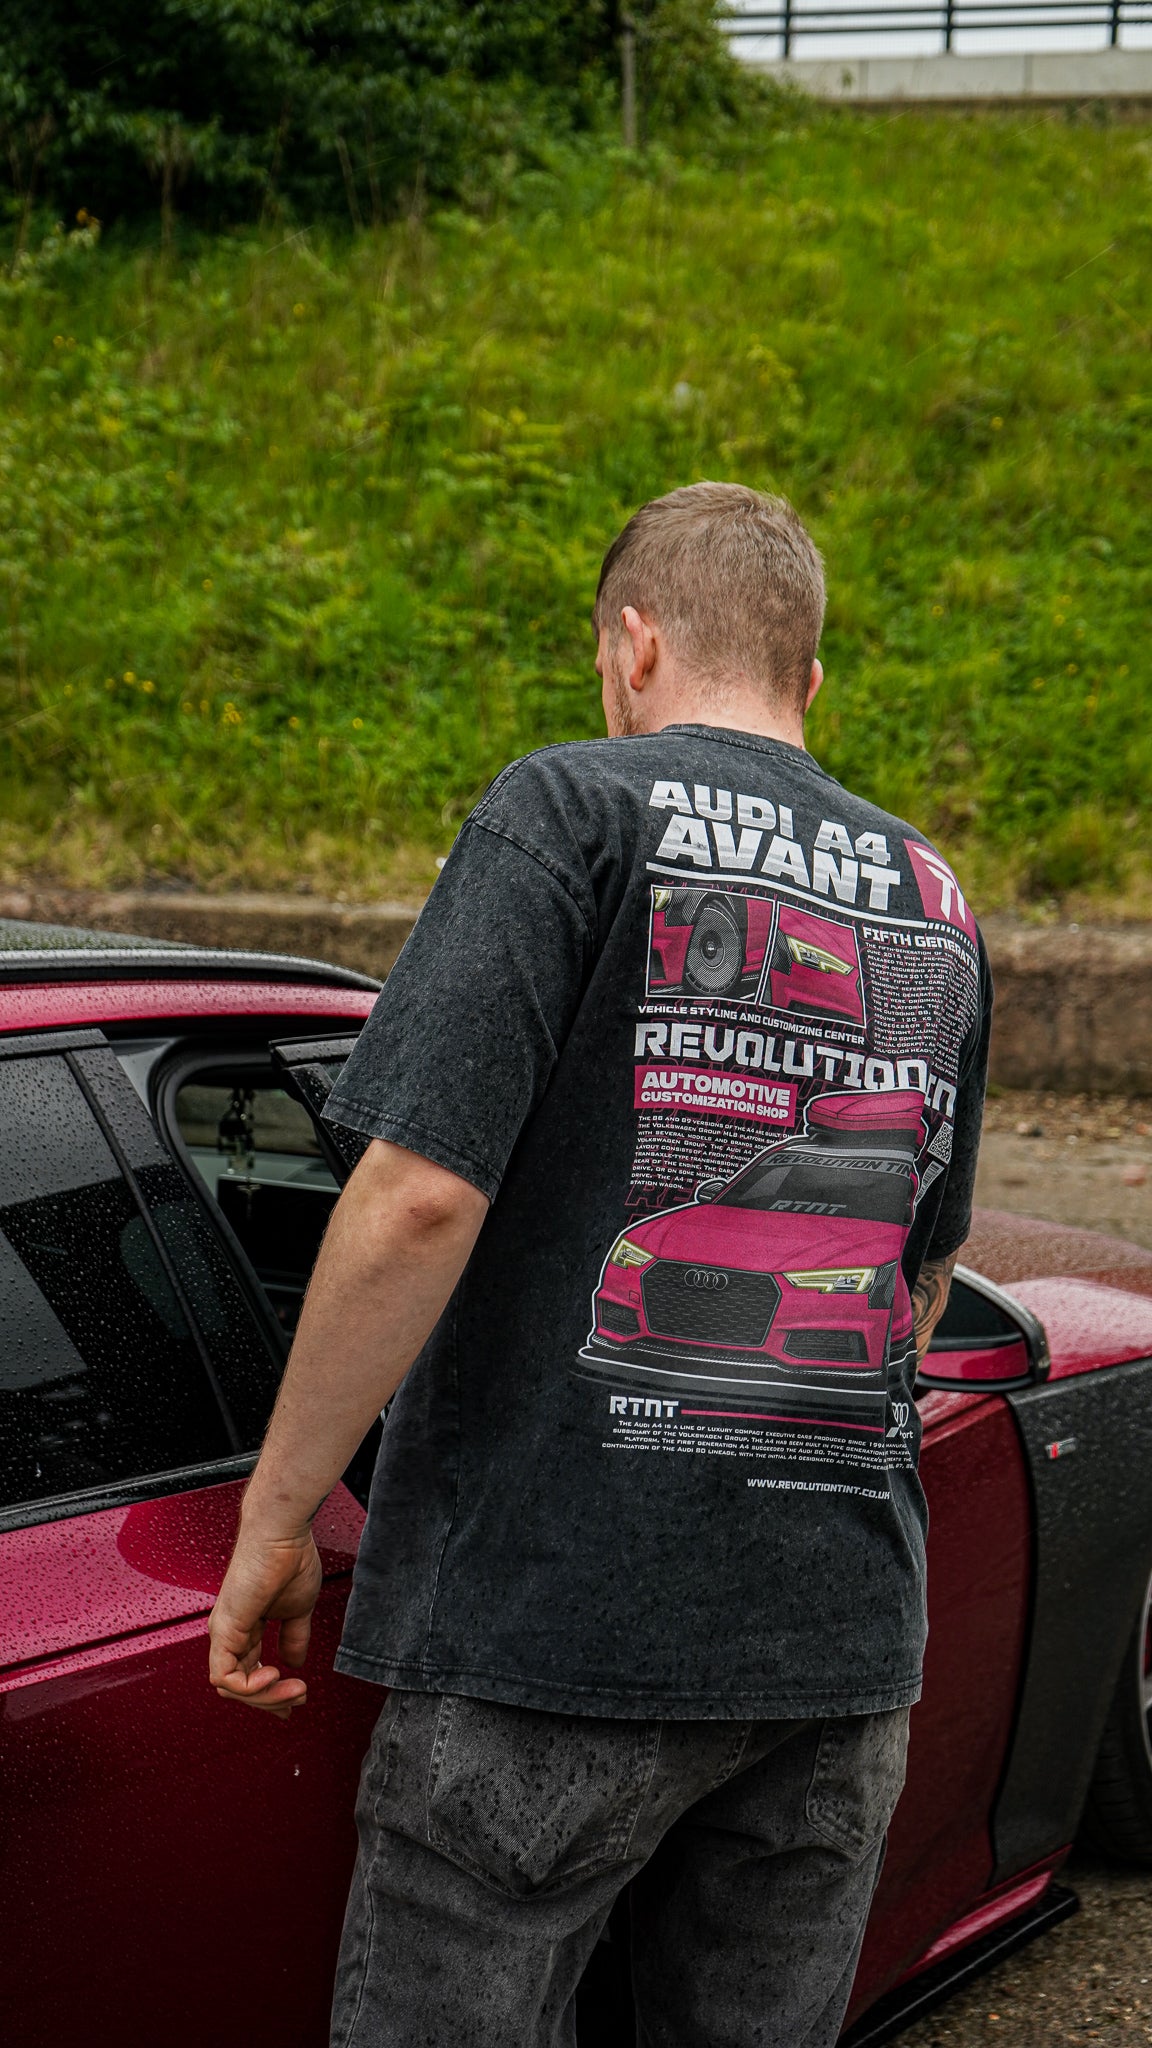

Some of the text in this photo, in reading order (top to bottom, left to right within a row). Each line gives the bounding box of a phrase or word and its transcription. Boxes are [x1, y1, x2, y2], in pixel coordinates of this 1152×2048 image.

[649, 780, 891, 866] AUDI A4
[655, 813, 901, 911] AVANT
[862, 926, 912, 947] FIFTH
[638, 1005, 865, 1046] VEHICLE STYLING AND CUSTOMIZING CENTER
[634, 1022, 928, 1093] REVOLUTION
[641, 1071, 791, 1107] AUTOMOTIVE
[640, 1091, 789, 1120] CUSTOMIZATION SHOP
[652, 1122, 697, 1132] VOLKSWAGEN
[655, 1130, 685, 1138] SEVERAL
[637, 1137, 681, 1145] VOLKSWAGEN
[768, 1153, 911, 1178] REVOLUTION TIN
[630, 1179, 658, 1187] STATION
[609, 1395, 679, 1418] RTNT
[612, 1428, 651, 1436] SUBSIDIARY
[678, 1431, 723, 1440] VOLKSWAGEN
[633, 1421, 650, 1429] AUDI
[734, 1428, 765, 1436] COMPACT
[765, 1431, 796, 1439] EXECUTIVE
[814, 1435, 847, 1444] PRODUCED
[601, 1442, 650, 1450] CONTINUATION
[697, 1440, 738, 1449] GENERATION
[747, 1478, 890, 1500] WWW.REVOLUTIONTINT.CO.UK
